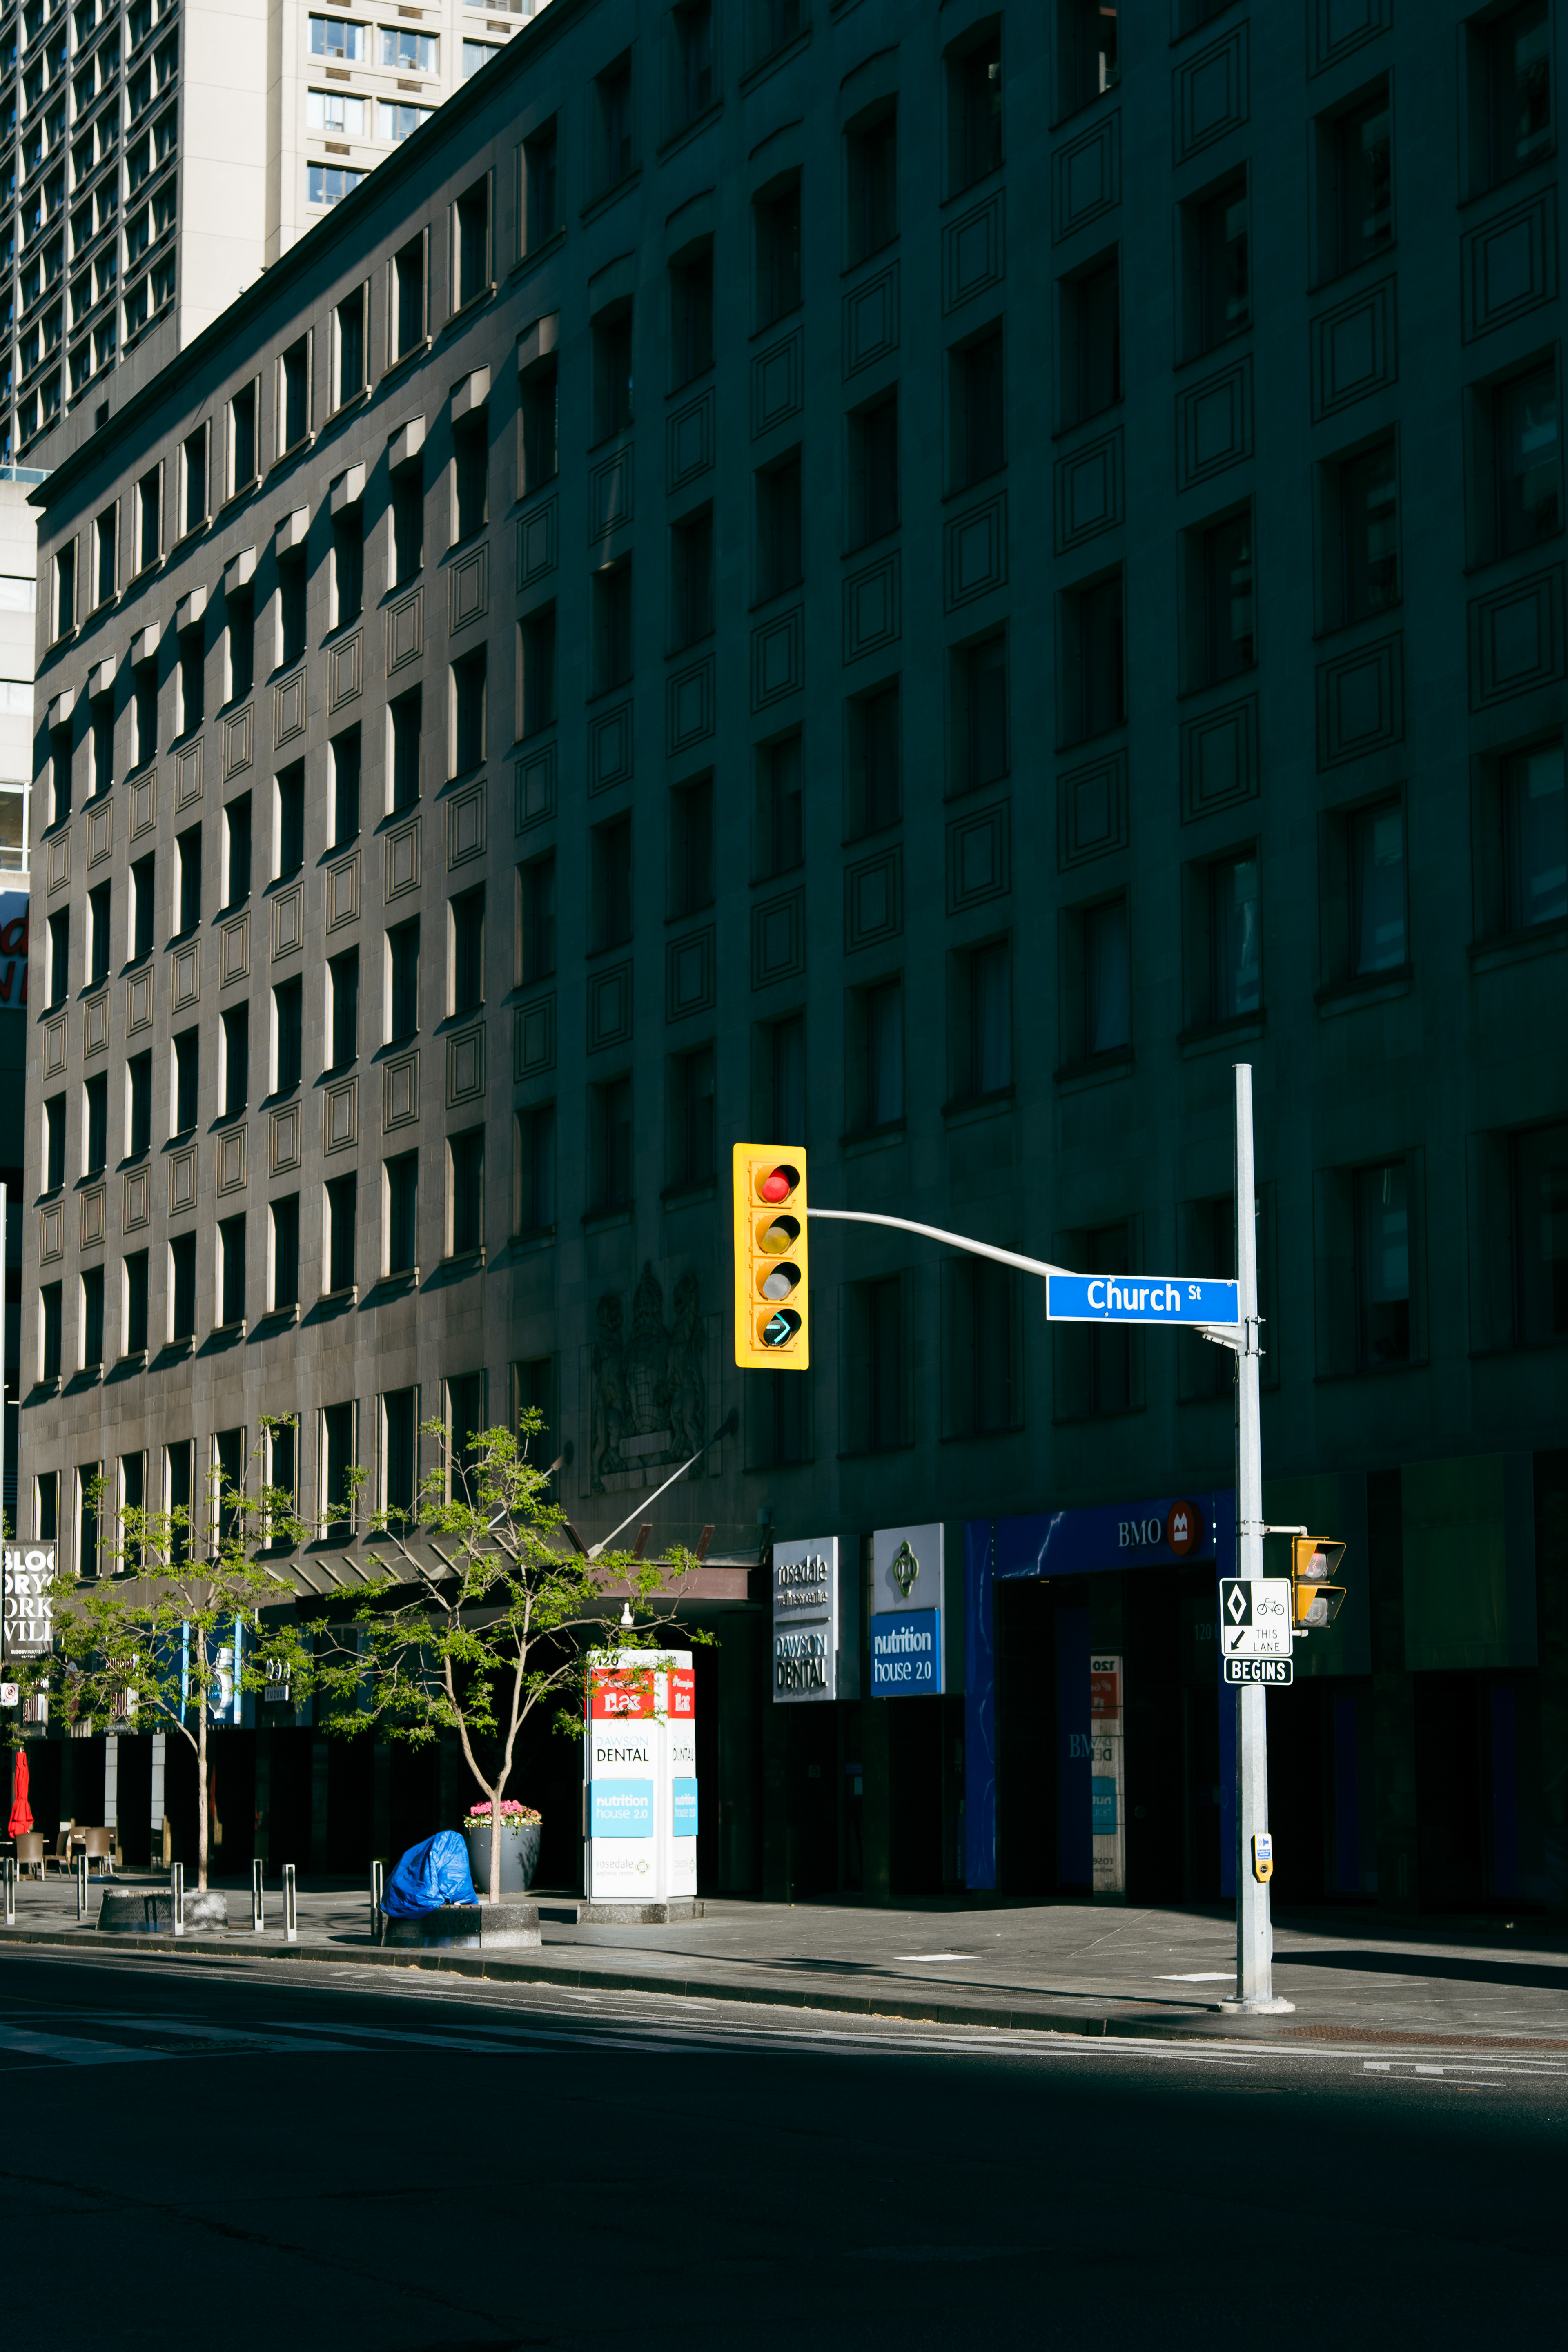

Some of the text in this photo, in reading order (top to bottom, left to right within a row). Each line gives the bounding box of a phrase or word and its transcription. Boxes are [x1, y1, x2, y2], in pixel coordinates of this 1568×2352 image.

[1087, 1281, 1202, 1311] Church St
[1118, 1518, 1161, 1547] BMO
[778, 1554, 828, 1585] rosedale
[875, 1626, 931, 1654] nutrition
[1256, 1629, 1277, 1639] THIS
[777, 1633, 828, 1658] DAWSON
[1254, 1642, 1280, 1651] LANE
[777, 1658, 829, 1689] DENTAL
[875, 1658, 931, 1682] house 2.0
[1232, 1660, 1286, 1681] BEGINS
[596, 1736, 649, 1747] DAWSON
[597, 1748, 649, 1762] DENTAL
[596, 1794, 648, 1806] nutrition
[596, 1807, 648, 1819] house 2.0
[597, 1859, 633, 1869] rosedale
